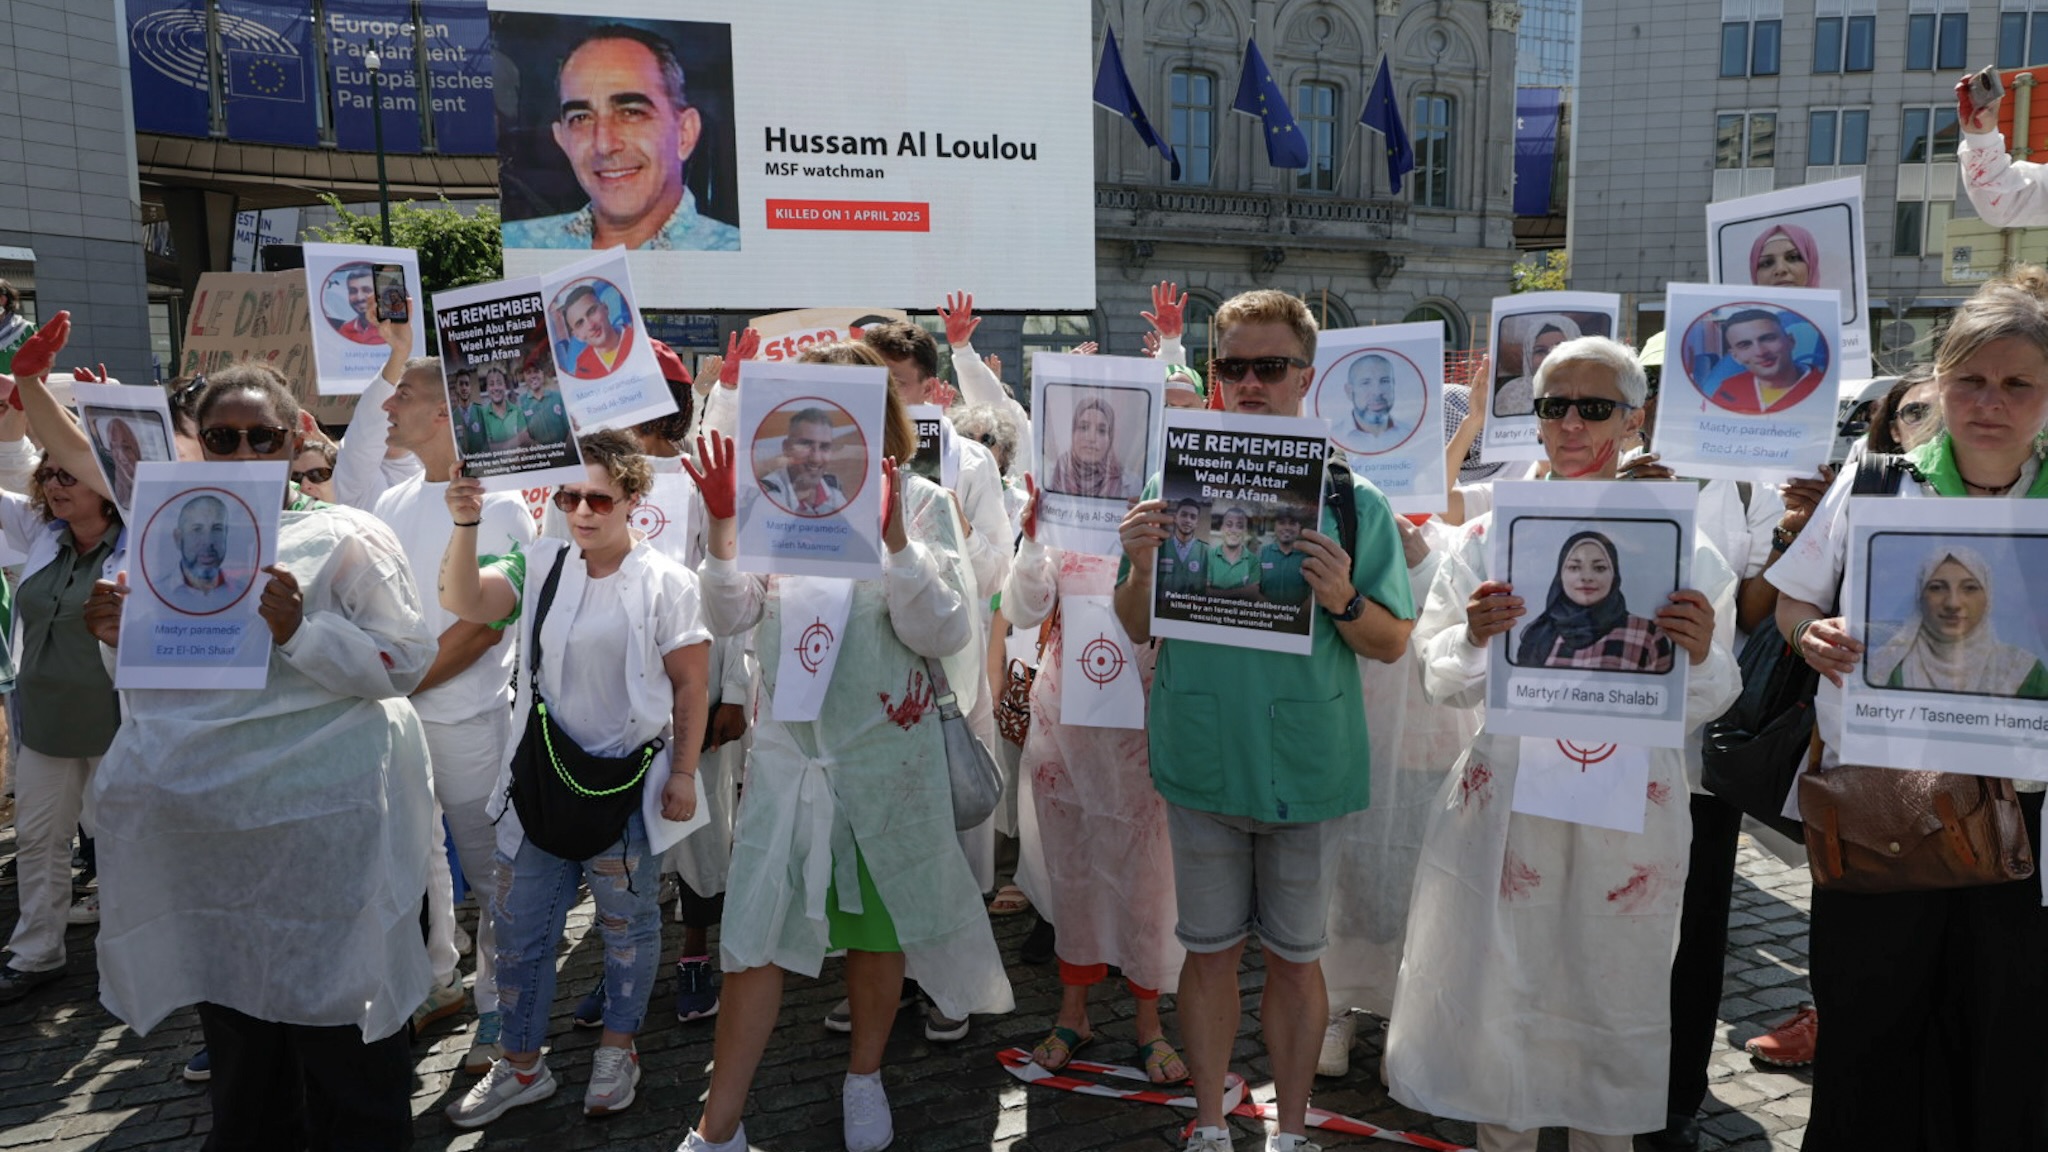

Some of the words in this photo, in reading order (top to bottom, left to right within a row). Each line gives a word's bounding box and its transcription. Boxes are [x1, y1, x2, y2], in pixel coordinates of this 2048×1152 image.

[330, 13, 449, 39] European
[333, 38, 467, 61] Pariament
[336, 66, 494, 91] Europäisches
[338, 90, 466, 112] Parament
[765, 126, 888, 156] Hussam
[897, 131, 926, 157] Al
[936, 133, 1037, 160] Loulou
[765, 162, 799, 177] MSF
[803, 164, 885, 179] watchman
[775, 208, 820, 220] KILLED
[822, 209, 842, 221] ON
[844, 209, 851, 221] 1
[854, 210, 890, 222] APRIL
[892, 211, 921, 223] 2025
[191, 290, 234, 337] LE
[438, 311, 459, 328] WE
[461, 296, 543, 324] REMEMBER
[448, 326, 484, 342] Hussein
[485, 323, 504, 336] Abu
[506, 317, 536, 332] Faisal
[460, 339, 483, 353] Wael
[485, 334, 524, 348] Al-Attar
[467, 353, 489, 365] Bara
[491, 348, 520, 361] Afana
[1495, 430, 1521, 440] Martyr
[1700, 421, 1738, 436] Martyr
[1740, 425, 1802, 439] paramedic
[1168, 431, 1200, 450] WE
[1205, 434, 1324, 460] REMEMBER
[1702, 441, 1733, 455] Raed
[1734, 445, 1789, 459] Al-Sharif
[1178, 453, 1233, 470] Hussein
[1236, 459, 1264, 473] Abu
[1267, 461, 1310, 476] Faisal
[1195, 469, 1228, 484] Wael
[1231, 473, 1289, 489] Al-Attar
[1202, 485, 1234, 500] Bara
[1236, 489, 1278, 503] Afana
[1091, 511, 1122, 524] Al-Sha
[766, 521, 797, 533] Martyr
[798, 523, 848, 535] paramedic
[1165, 590, 1208, 603] Palestinian
[1208, 597, 1252, 609] paramedics
[1253, 601, 1301, 614] deliberately
[1170, 601, 1192, 610] killed
[1192, 603, 1202, 613] by
[1203, 605, 1213, 613] an
[1214, 606, 1238, 615] Israeli
[1239, 609, 1272, 619] airstrike
[1273, 612, 1295, 622] while
[190, 624, 241, 636] paramedic
[1190, 613, 1222, 625] rescuing
[1223, 615, 1236, 625] the
[1237, 618, 1273, 629] wounded
[156, 645, 174, 656] Ezz
[176, 645, 206, 656] El-Din
[1516, 684, 1560, 703] Martyr
[1562, 688, 1569, 700] /
[1571, 688, 1605, 703] Rana
[1608, 689, 1659, 706] Shalabi
[1855, 703, 1906, 722] Martyr
[1909, 707, 1916, 720] /
[1920, 707, 1990, 726] Tasneem
[1994, 713, 2048, 732] Hamda
